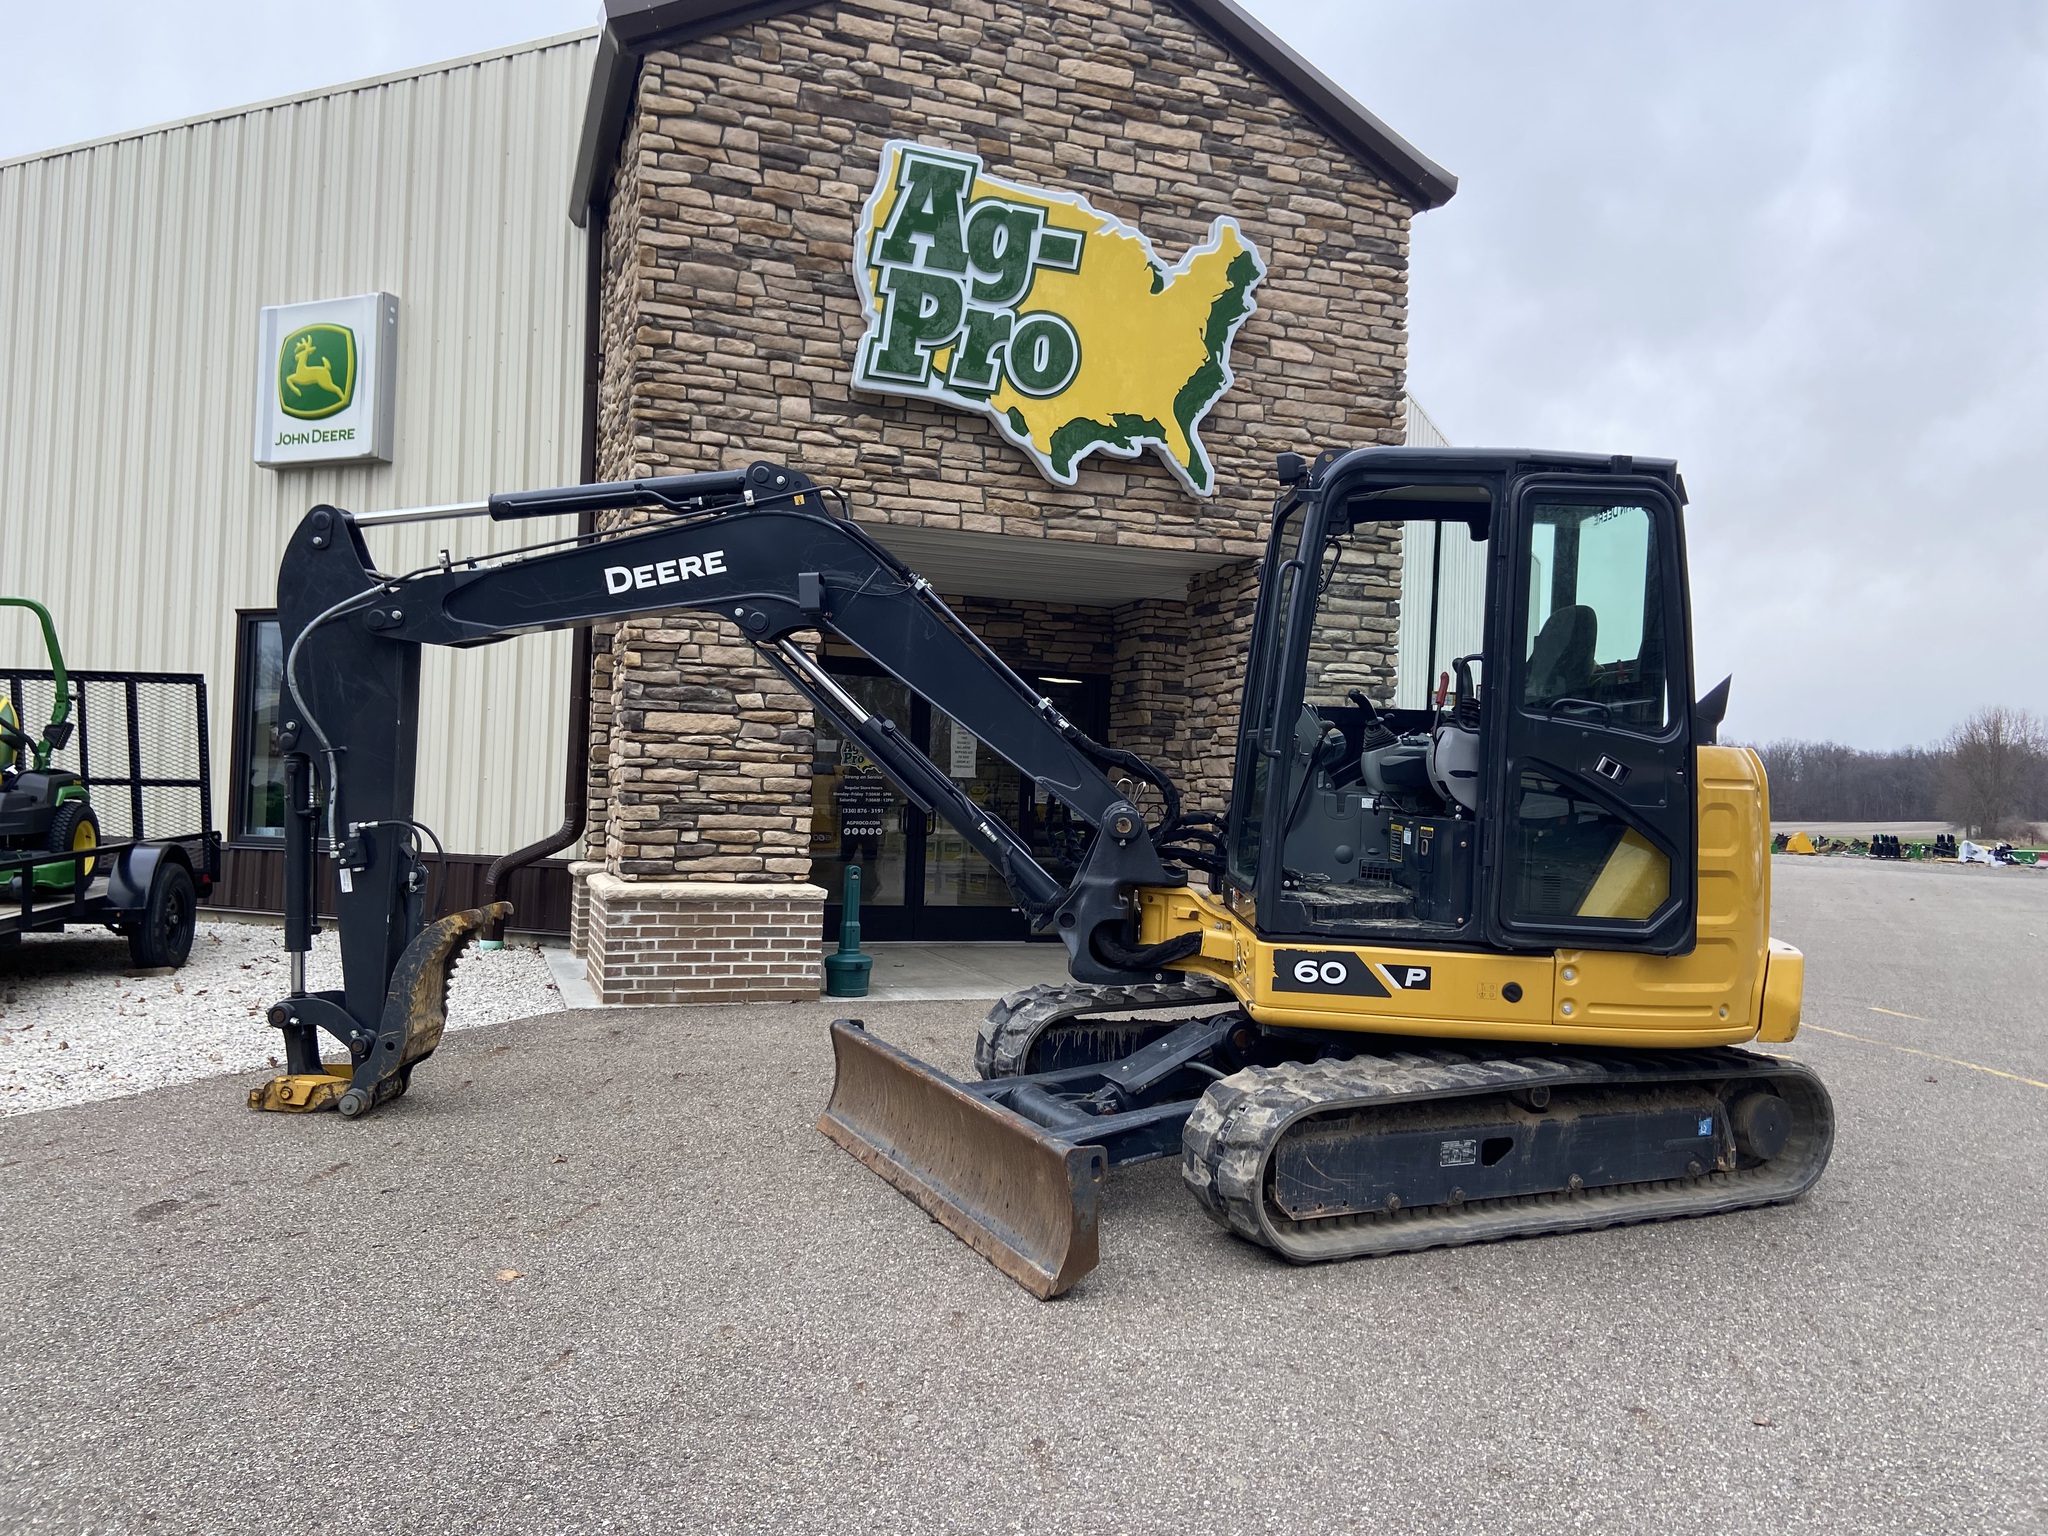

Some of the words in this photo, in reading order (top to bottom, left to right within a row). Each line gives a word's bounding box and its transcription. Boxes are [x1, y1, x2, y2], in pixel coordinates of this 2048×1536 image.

[868, 149, 1087, 305] Ag-
[865, 269, 1081, 398] Pro
[274, 431, 309, 446] JOHN
[311, 428, 356, 443] DEERE
[604, 550, 727, 595] DEERE
[844, 753, 864, 763] Pro
[1293, 960, 1347, 985] 60
[1404, 968, 1427, 987] P
